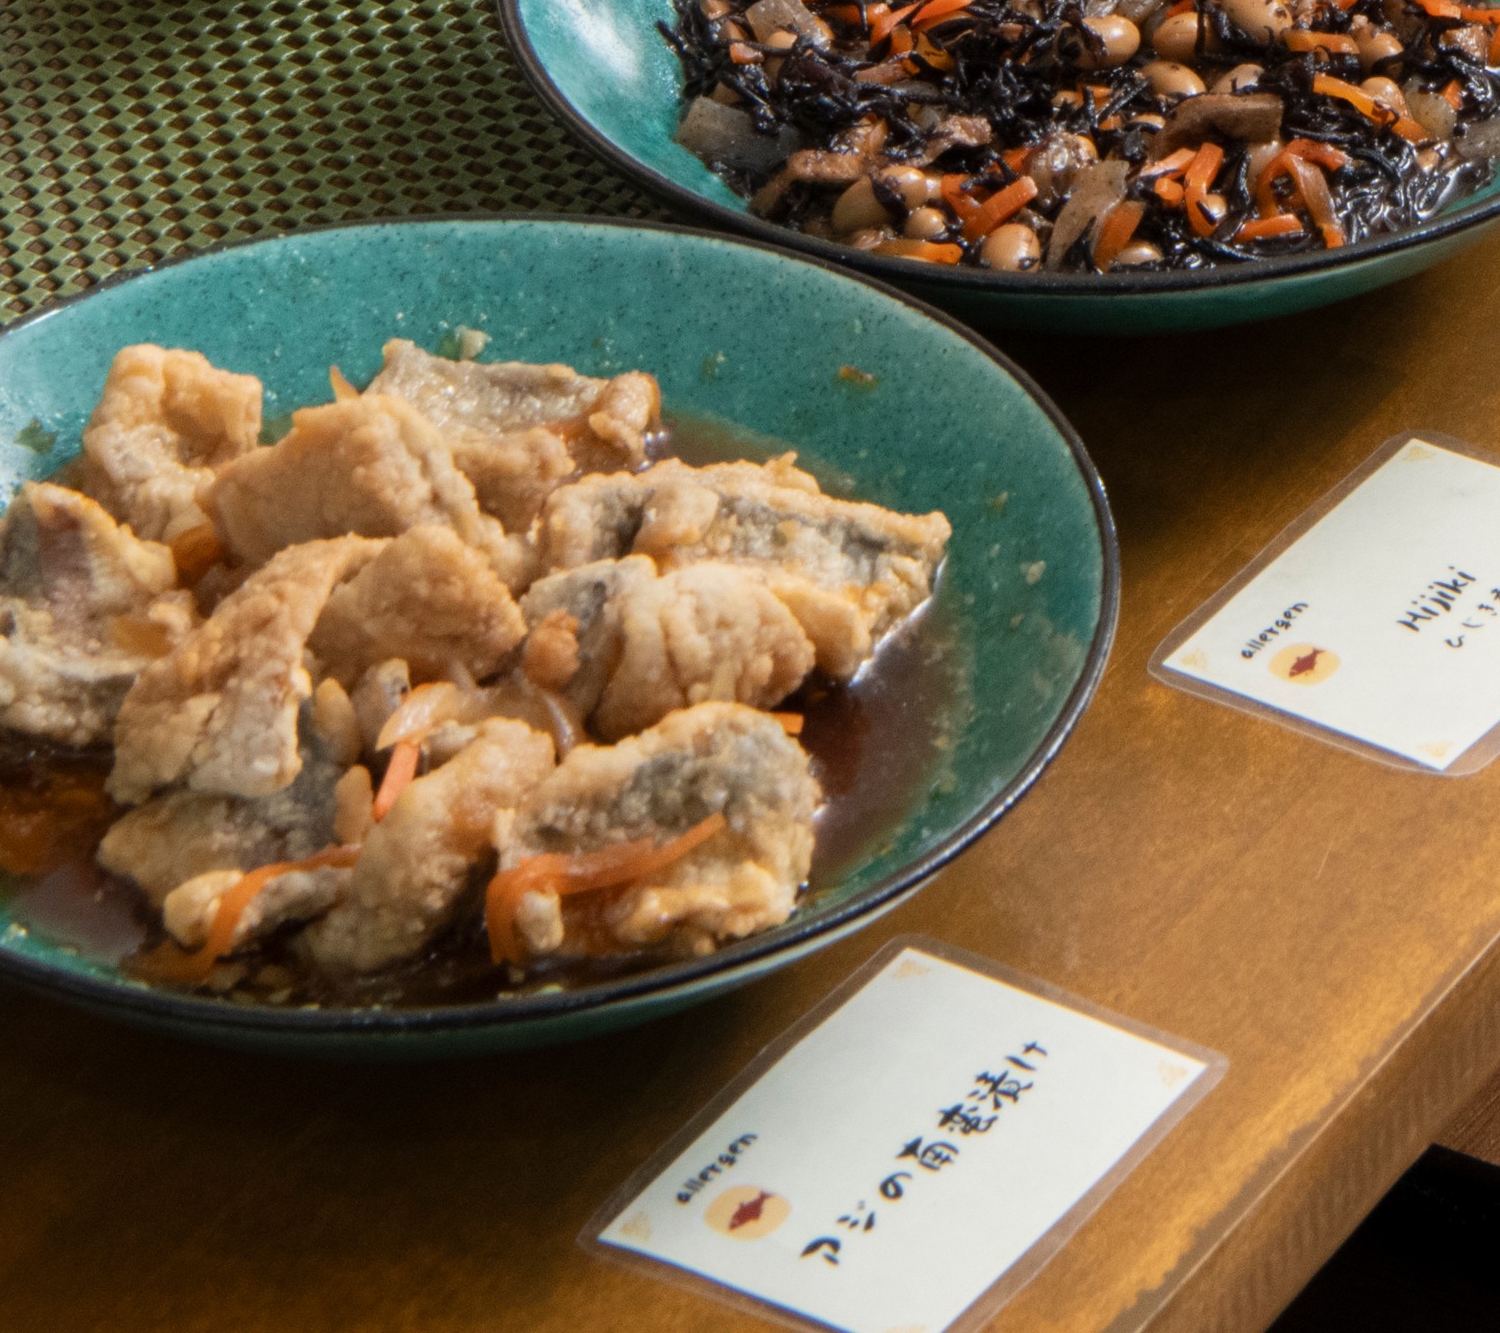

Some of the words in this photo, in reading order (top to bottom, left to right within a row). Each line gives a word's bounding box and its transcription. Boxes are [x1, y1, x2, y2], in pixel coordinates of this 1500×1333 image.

[1240, 600, 1309, 660] allergen
[1396, 565, 1477, 632] Hijiki
[674, 1132, 759, 1207] allergen
[799, 1040, 1049, 1267] アジの南蛮漬け
